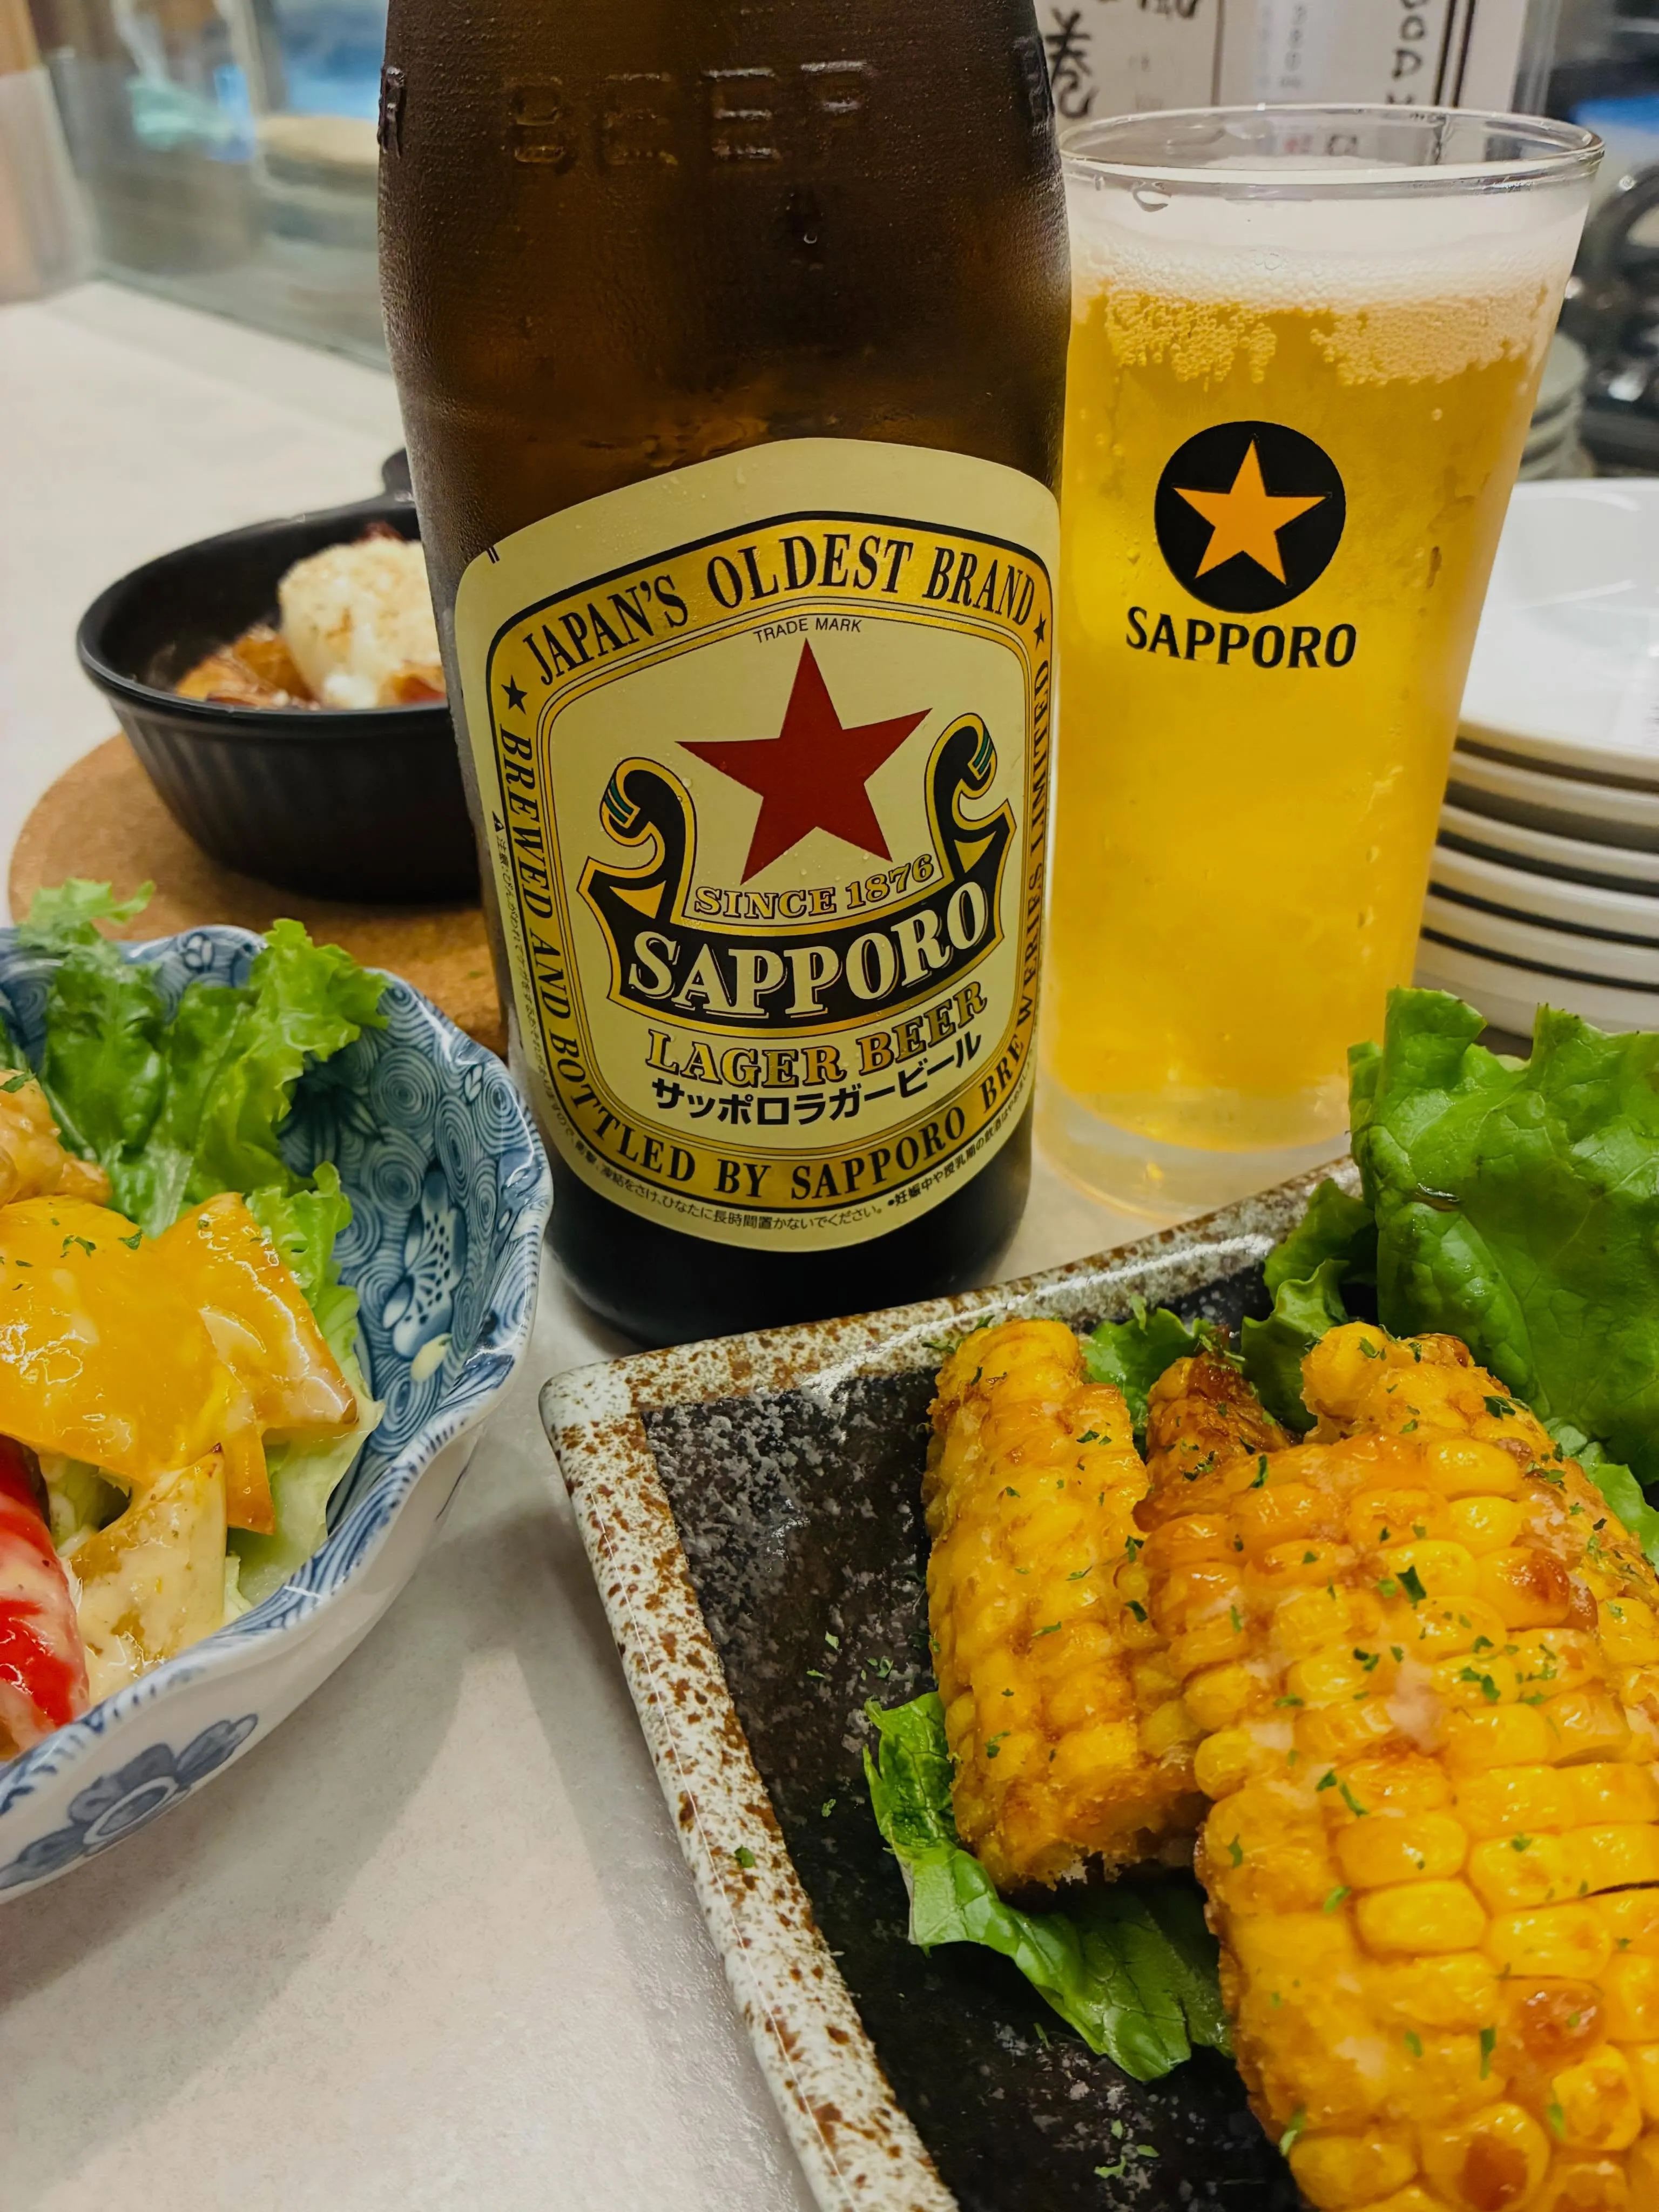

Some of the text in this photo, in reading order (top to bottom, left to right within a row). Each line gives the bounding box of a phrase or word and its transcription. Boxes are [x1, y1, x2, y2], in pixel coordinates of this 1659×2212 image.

[523, 534, 1035, 686] JAPAN'S OLDEST BRAND
[753, 617, 862, 644] TRADE MARK
[1125, 606, 1357, 669] SAPPORO
[1030, 659, 1049, 854] LIMITED
[500, 723, 553, 919] BREWED
[694, 854, 934, 919] SINCE 1876
[529, 927, 571, 1020] AND
[628, 881, 990, 1019] SAPPORO
[979, 862, 1043, 1114] BREWERIES
[646, 1028, 847, 1089] LAGER
[855, 980, 988, 1076] BEER
[651, 1030, 982, 1125] サッポロラガービール
[548, 1028, 696, 1182] BOTTLED
[791, 1107, 966, 1201] SAPPORO
[714, 1158, 771, 1198] BY
